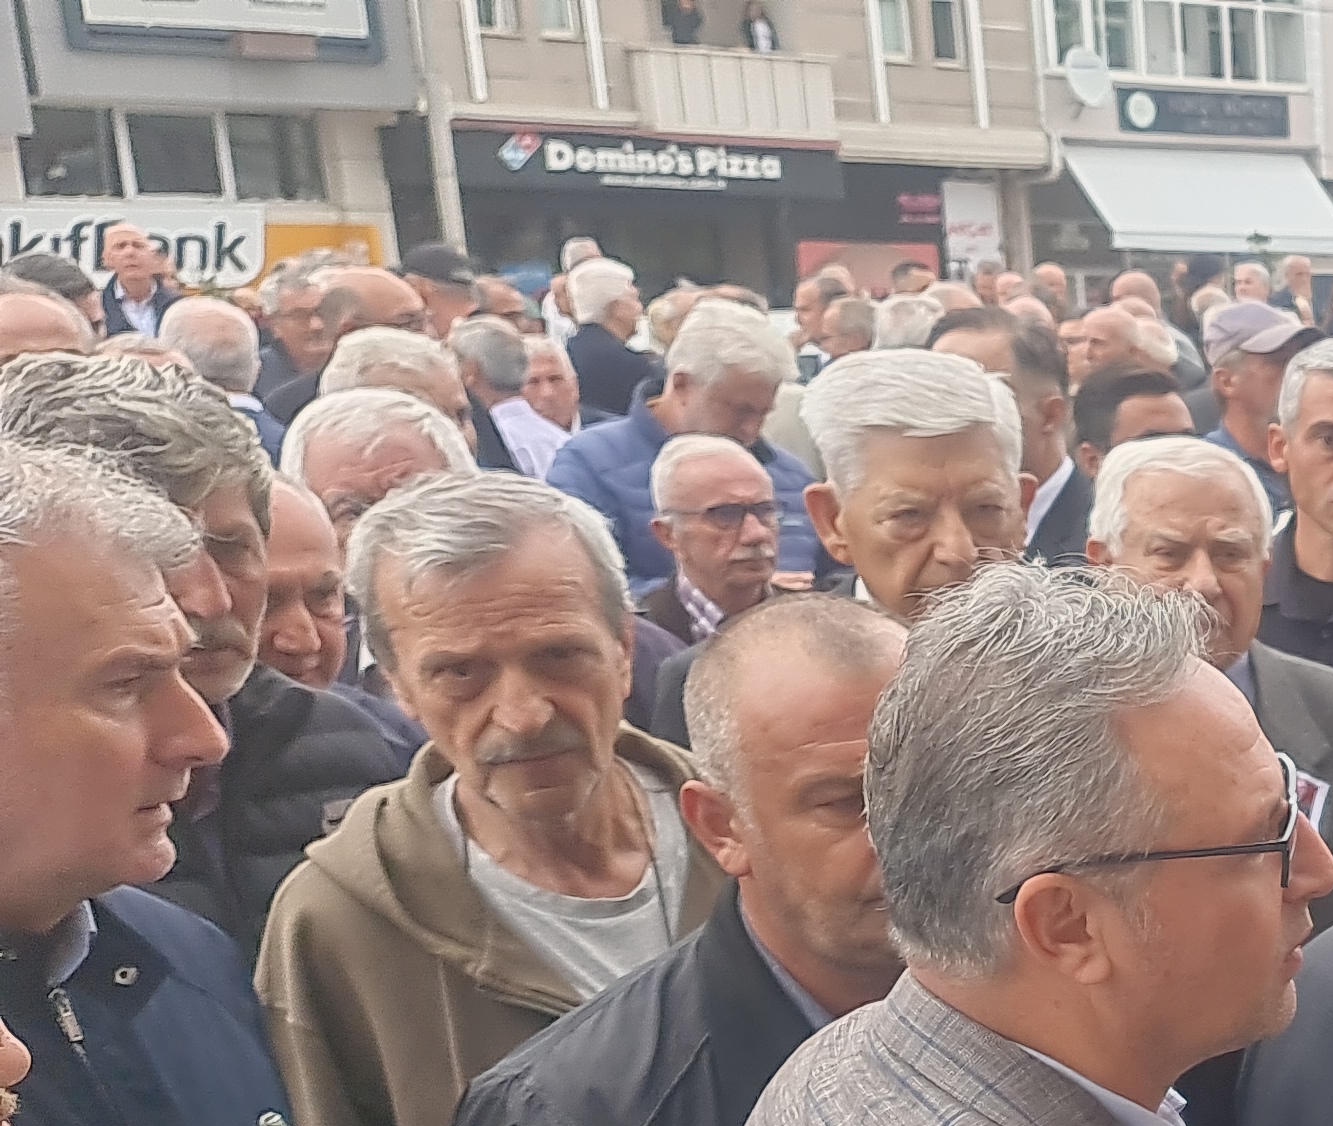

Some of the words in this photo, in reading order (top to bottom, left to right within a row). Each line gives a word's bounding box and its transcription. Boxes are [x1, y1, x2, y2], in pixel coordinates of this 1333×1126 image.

[544, 138, 695, 176] Domino's
[694, 145, 782, 180] Pizza
[0, 218, 247, 272] kıfBank
